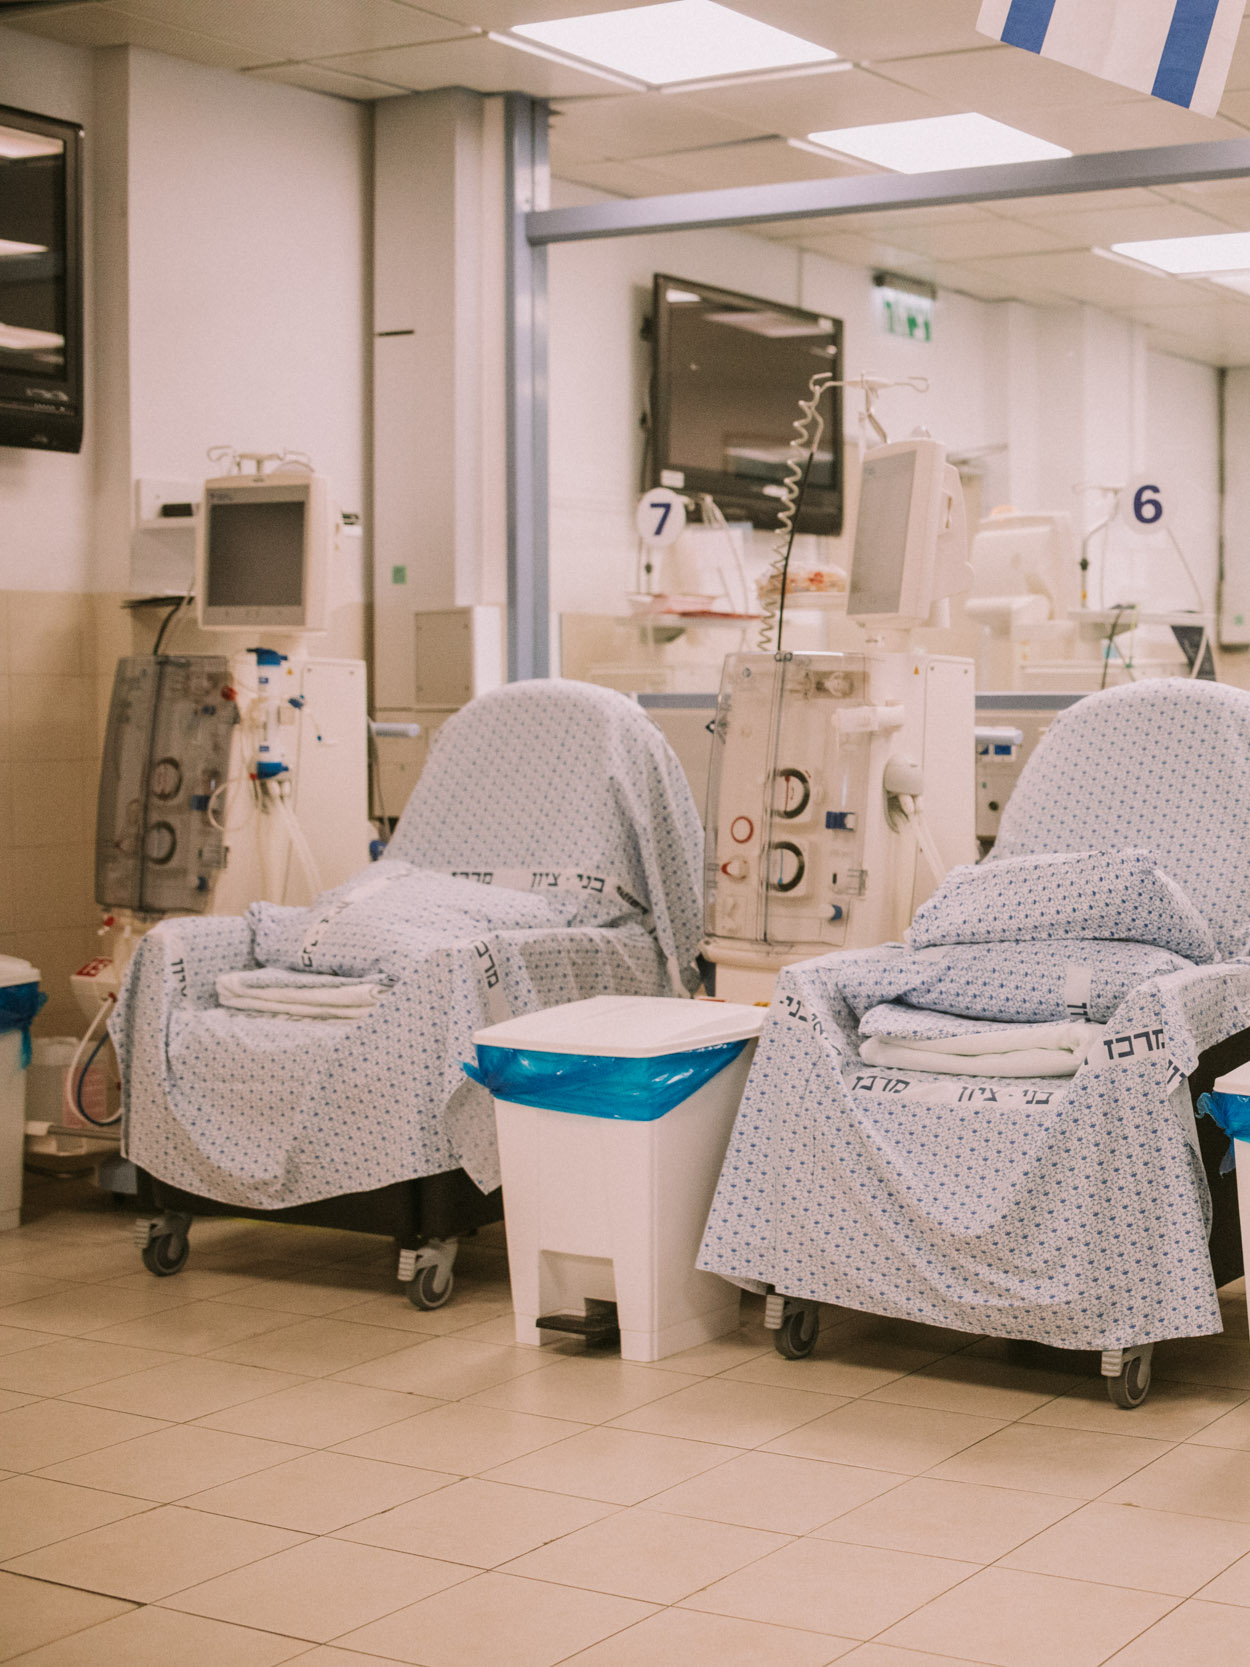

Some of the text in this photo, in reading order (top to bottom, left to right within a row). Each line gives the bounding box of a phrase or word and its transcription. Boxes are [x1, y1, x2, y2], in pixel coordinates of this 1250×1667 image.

[650, 503, 671, 536] 7
[1133, 485, 1162, 524] 6
[474, 940, 499, 988] מרכ
[851, 1075, 911, 1094] מרכז
[1021, 1088, 1054, 1105] בני
